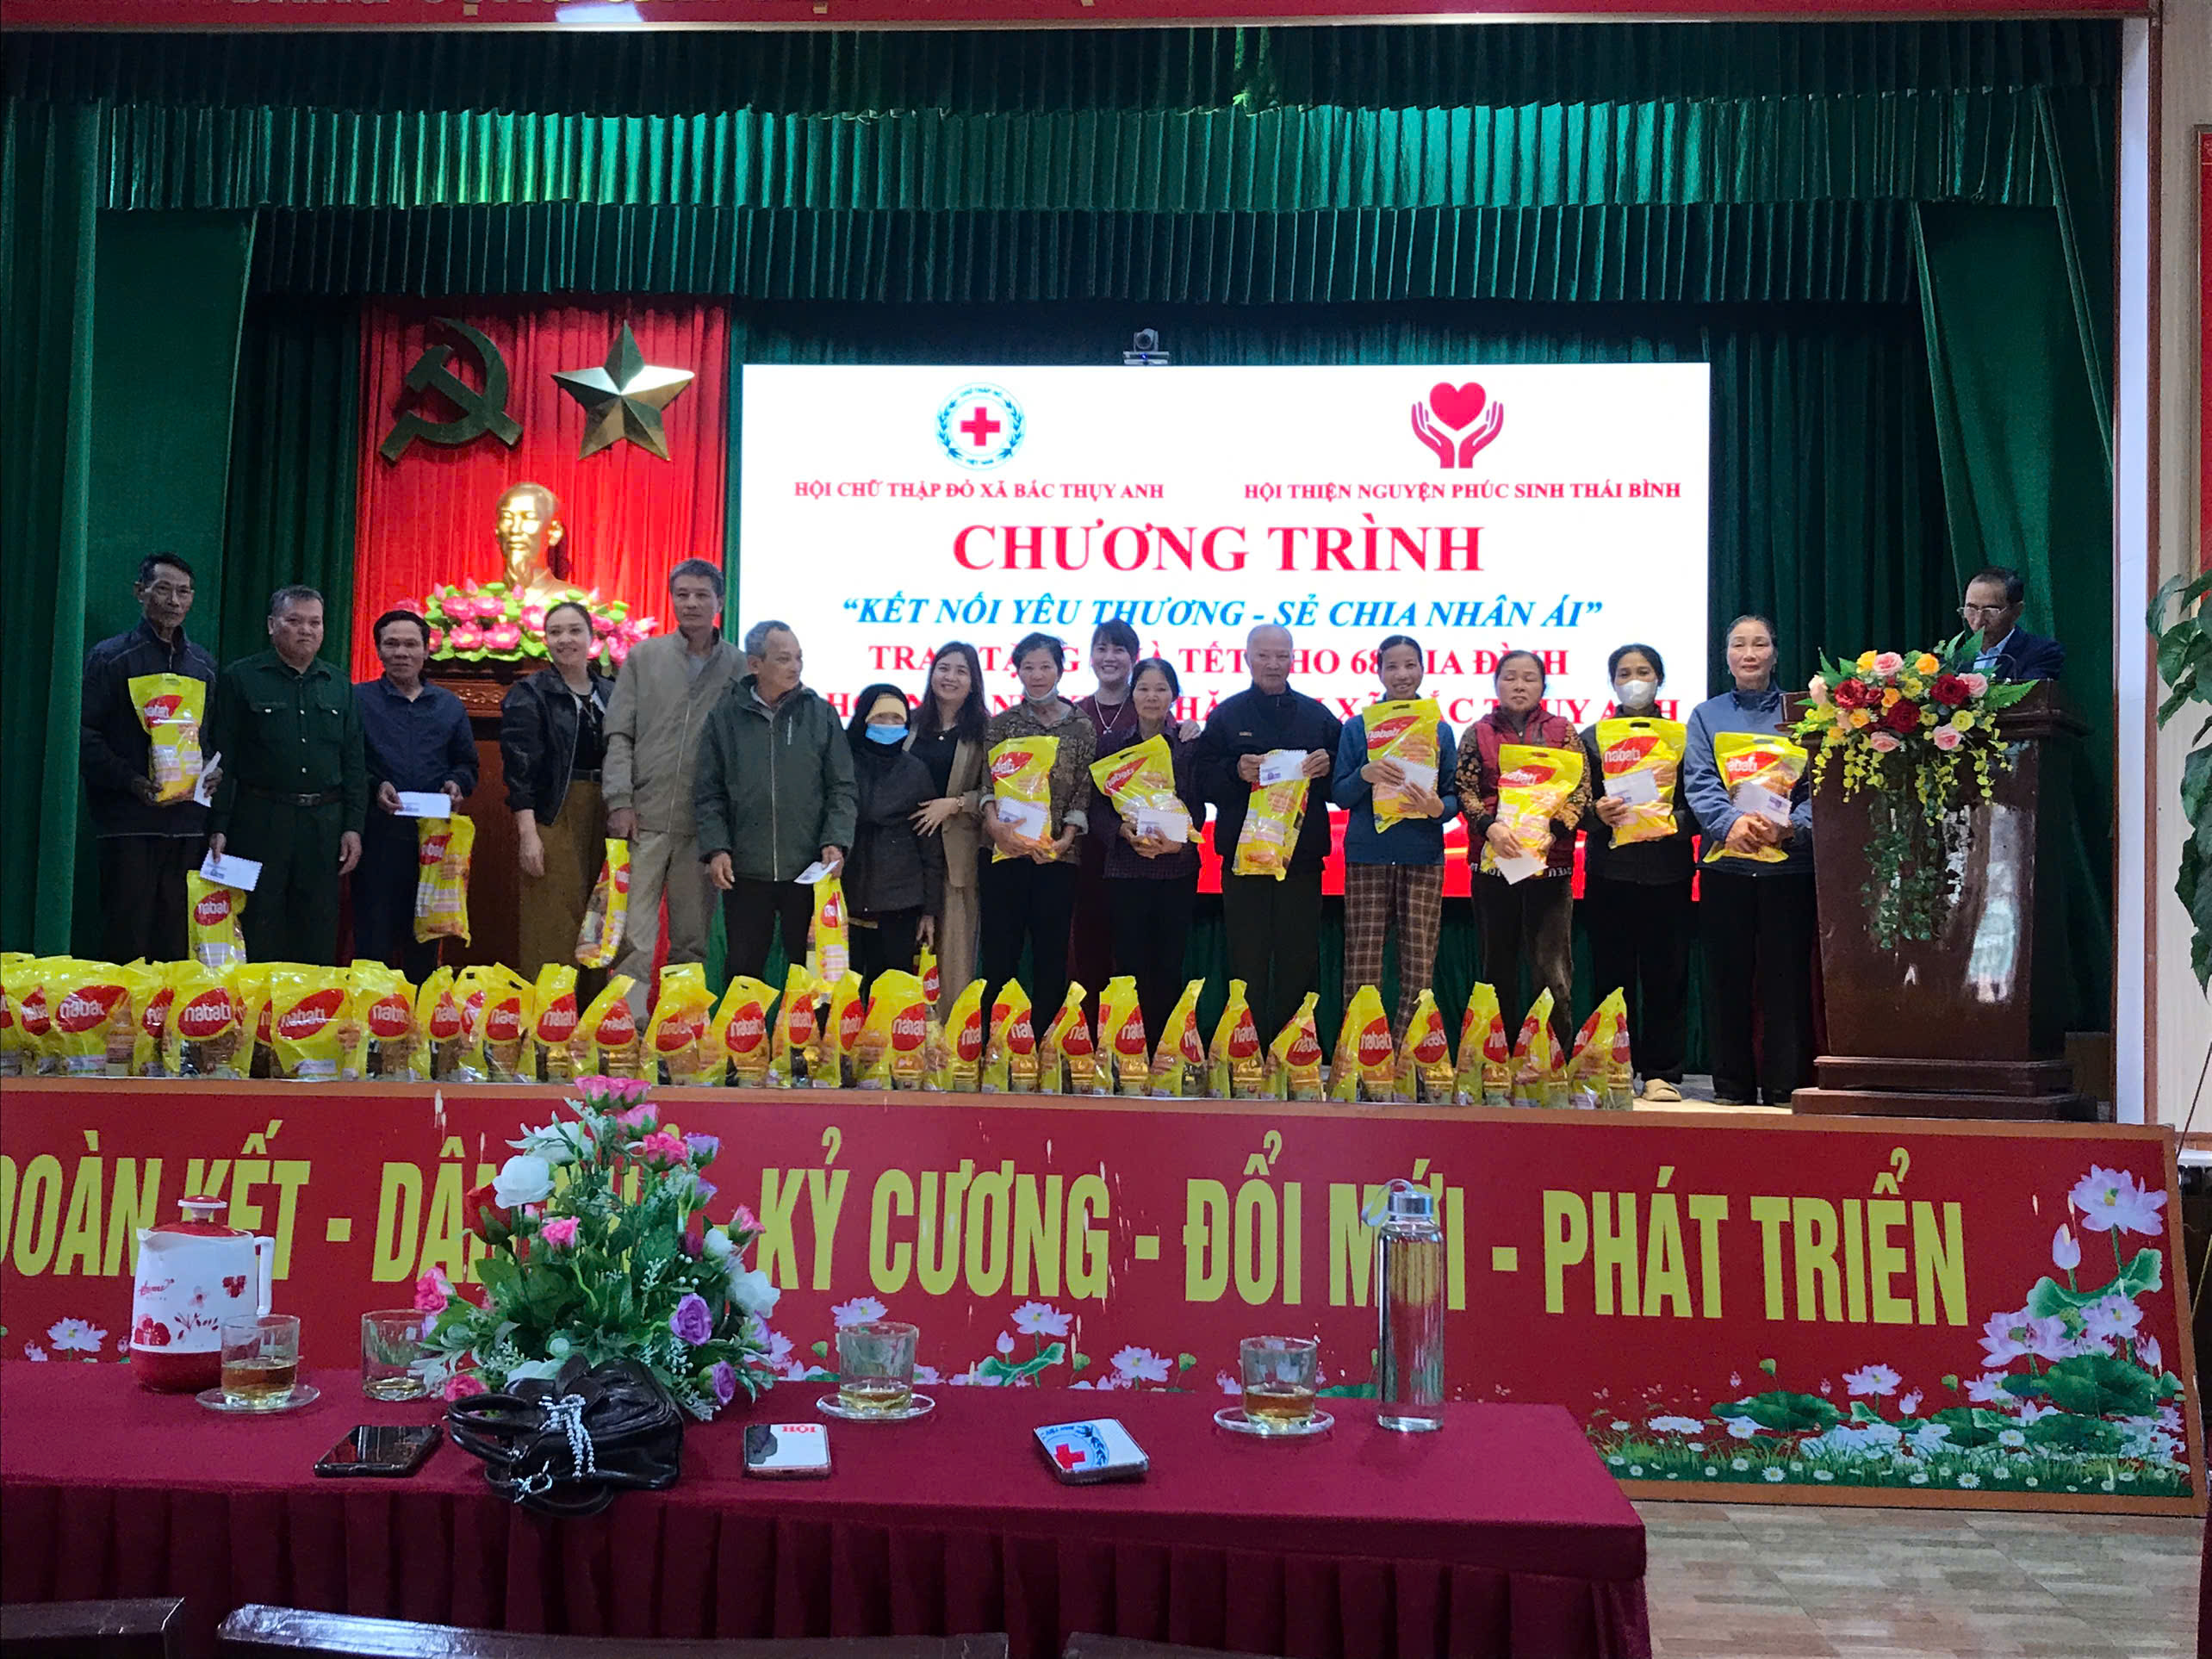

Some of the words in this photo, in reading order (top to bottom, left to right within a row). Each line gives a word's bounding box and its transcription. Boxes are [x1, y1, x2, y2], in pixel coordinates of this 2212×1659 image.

[794, 479, 831, 500] HỘI
[837, 479, 883, 497] CHỮ
[945, 479, 974, 498] ĐỎ
[1059, 483, 1116, 502] THỤY
[1120, 484, 1164, 499] ANH
[1245, 482, 1282, 502] HỘI
[1288, 482, 1351, 502] THIỆN
[1358, 482, 1445, 502] NGUYỆN
[1451, 479, 1509, 499] PHÚC
[1514, 482, 1564, 499] SINH
[1570, 479, 1622, 498] THÁI
[1628, 479, 1681, 498] BÌNH
[953, 518, 1249, 572] CHƯƠNG
[1268, 513, 1485, 572] TRÌNH
[935, 592, 1003, 624] NỐI
[1012, 593, 1080, 624] YÊU
[1091, 597, 1246, 625] THƯƠNG
[1274, 593, 1319, 626] SẺ
[1329, 601, 1416, 626] CHIA
[1425, 594, 1537, 626] NHÂN
[868, 645, 936, 670] TRA
[1178, 641, 1246, 674] TẾT
[1289, 649, 1340, 674] HO
[1424, 649, 1464, 674] IA
[1605, 747, 1641, 762] nabati
[1726, 756, 1758, 773] abati
[756, 1126, 849, 1290] KỶ
[869, 1159, 1109, 1299] CƯƠNG
[1183, 1130, 1302, 1305] ĐỔI
[1543, 1165, 1728, 1319] PHÁT
[1750, 1146, 1968, 1326] TRIỂN
